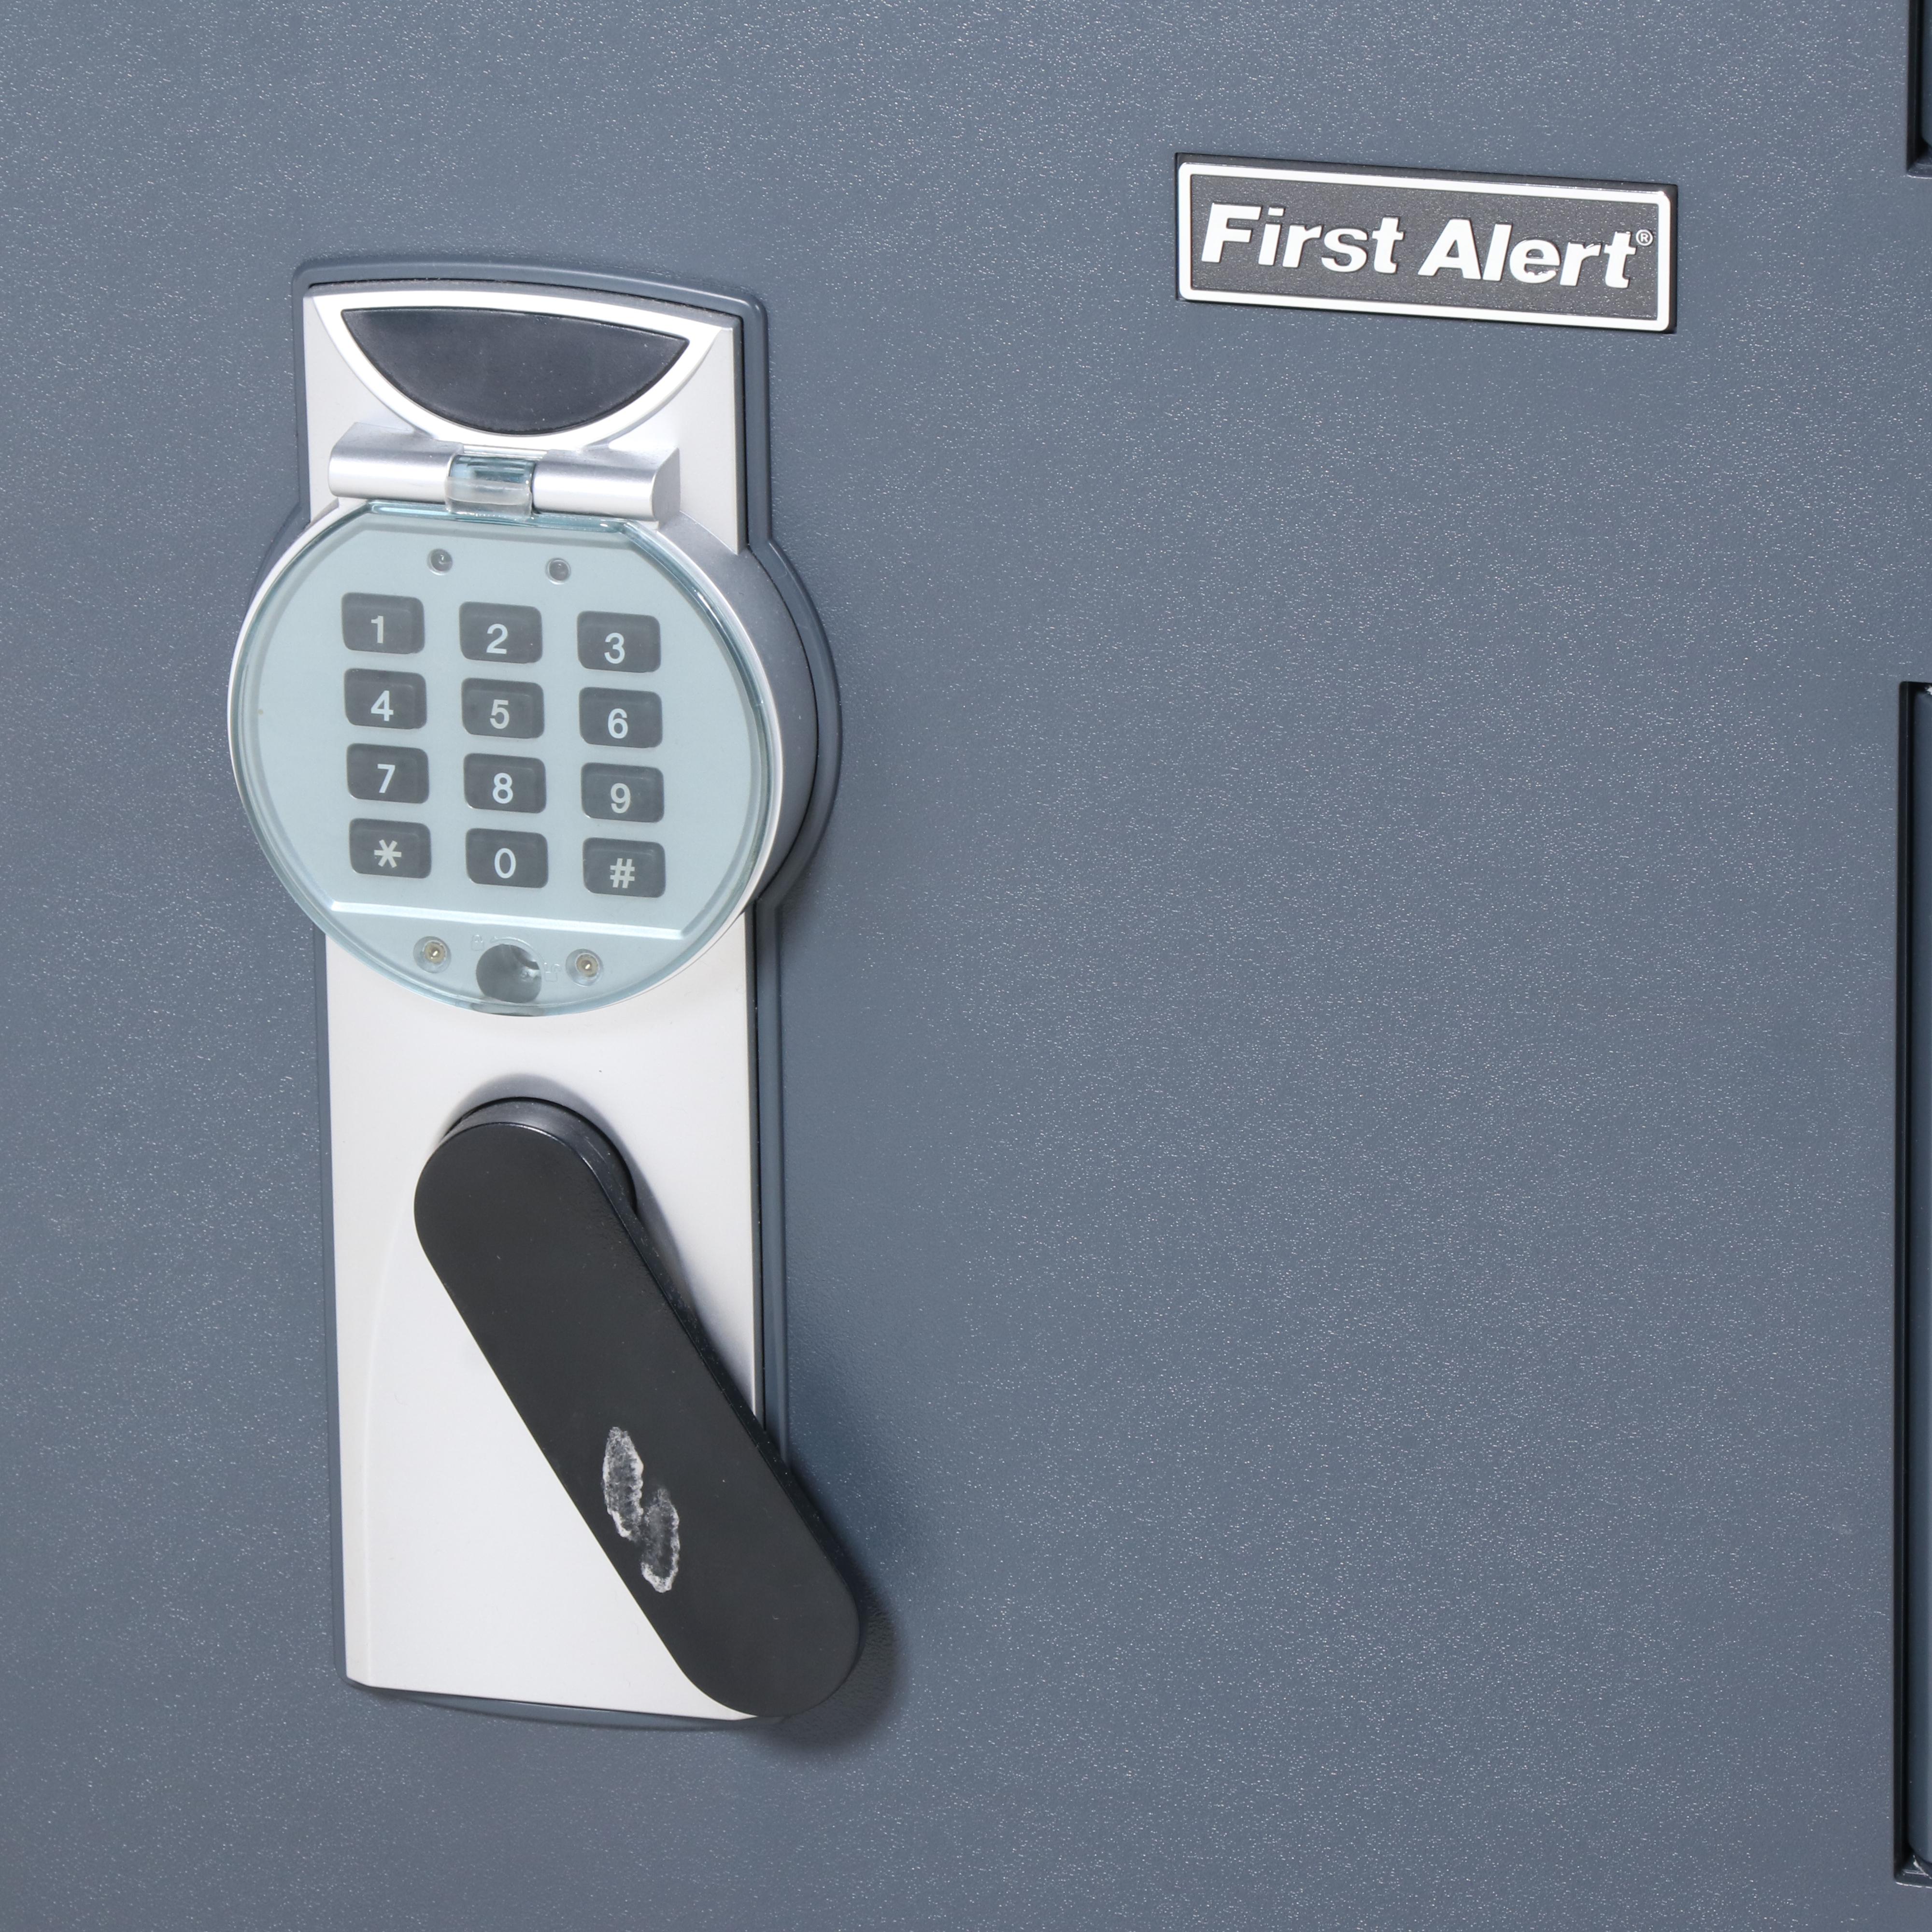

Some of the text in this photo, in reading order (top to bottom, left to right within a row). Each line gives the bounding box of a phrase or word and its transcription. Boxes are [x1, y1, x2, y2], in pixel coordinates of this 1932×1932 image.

[1201, 202, 1405, 274] First
[370, 615, 626, 664] 1 2 3
[370, 690, 629, 739] 4 5 6
[377, 764, 631, 814] 7 8 9
[494, 848, 516, 879] 0
[610, 858, 635, 889] #
